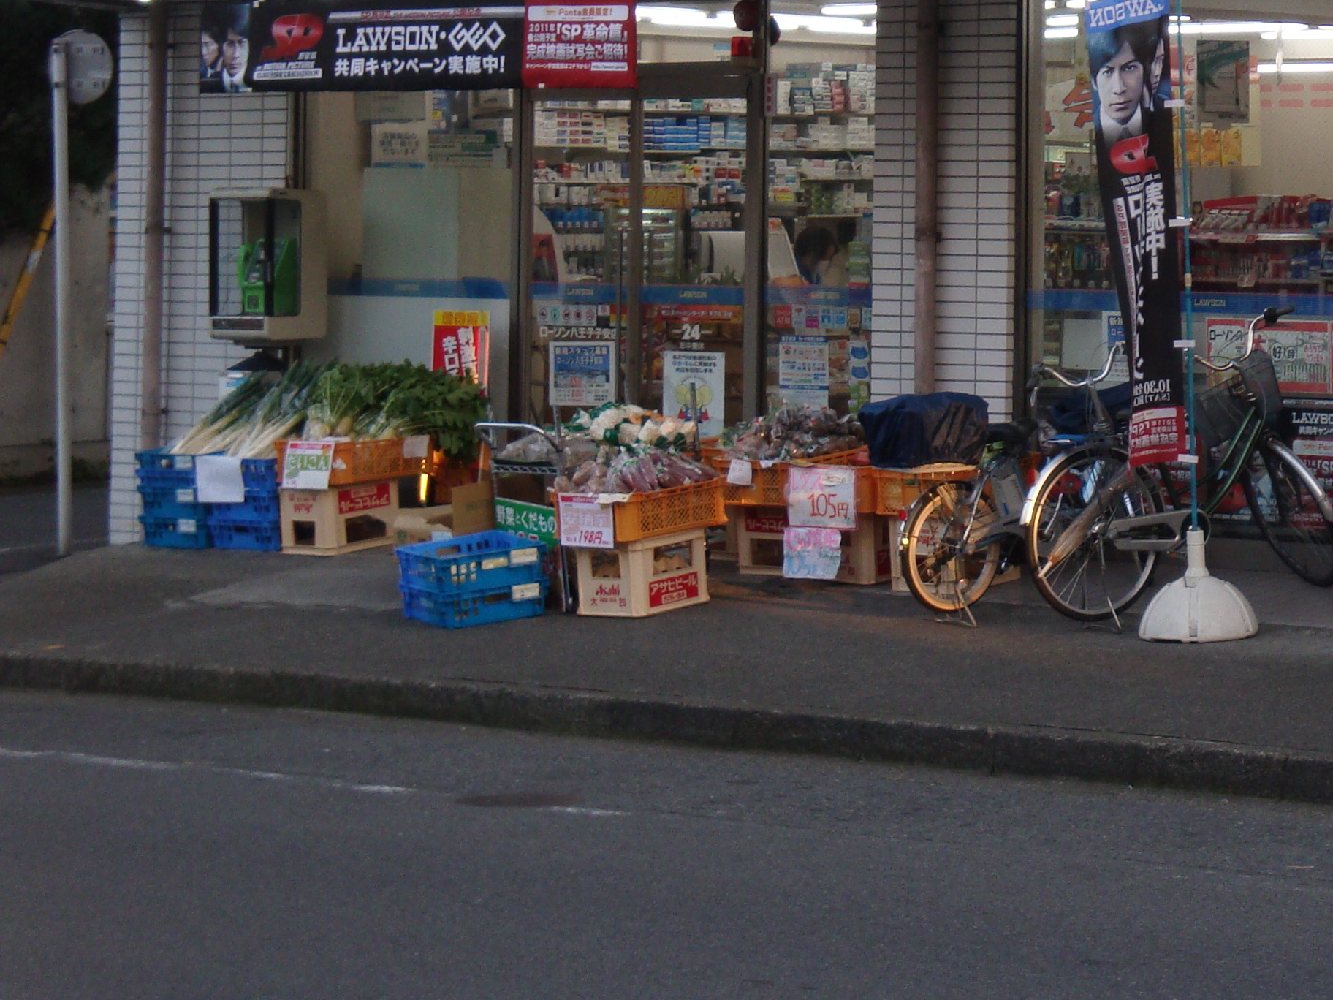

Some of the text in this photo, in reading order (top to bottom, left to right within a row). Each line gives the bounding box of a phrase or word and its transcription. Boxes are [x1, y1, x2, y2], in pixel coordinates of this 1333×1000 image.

[334, 55, 506, 78] 共同キャンペーン実施中!
[682, 323, 700, 340] 24
[807, 492, 849, 519] 105円
[495, 503, 557, 534] 野菜とくだもの
[649, 575, 698, 596] アサヒビール
